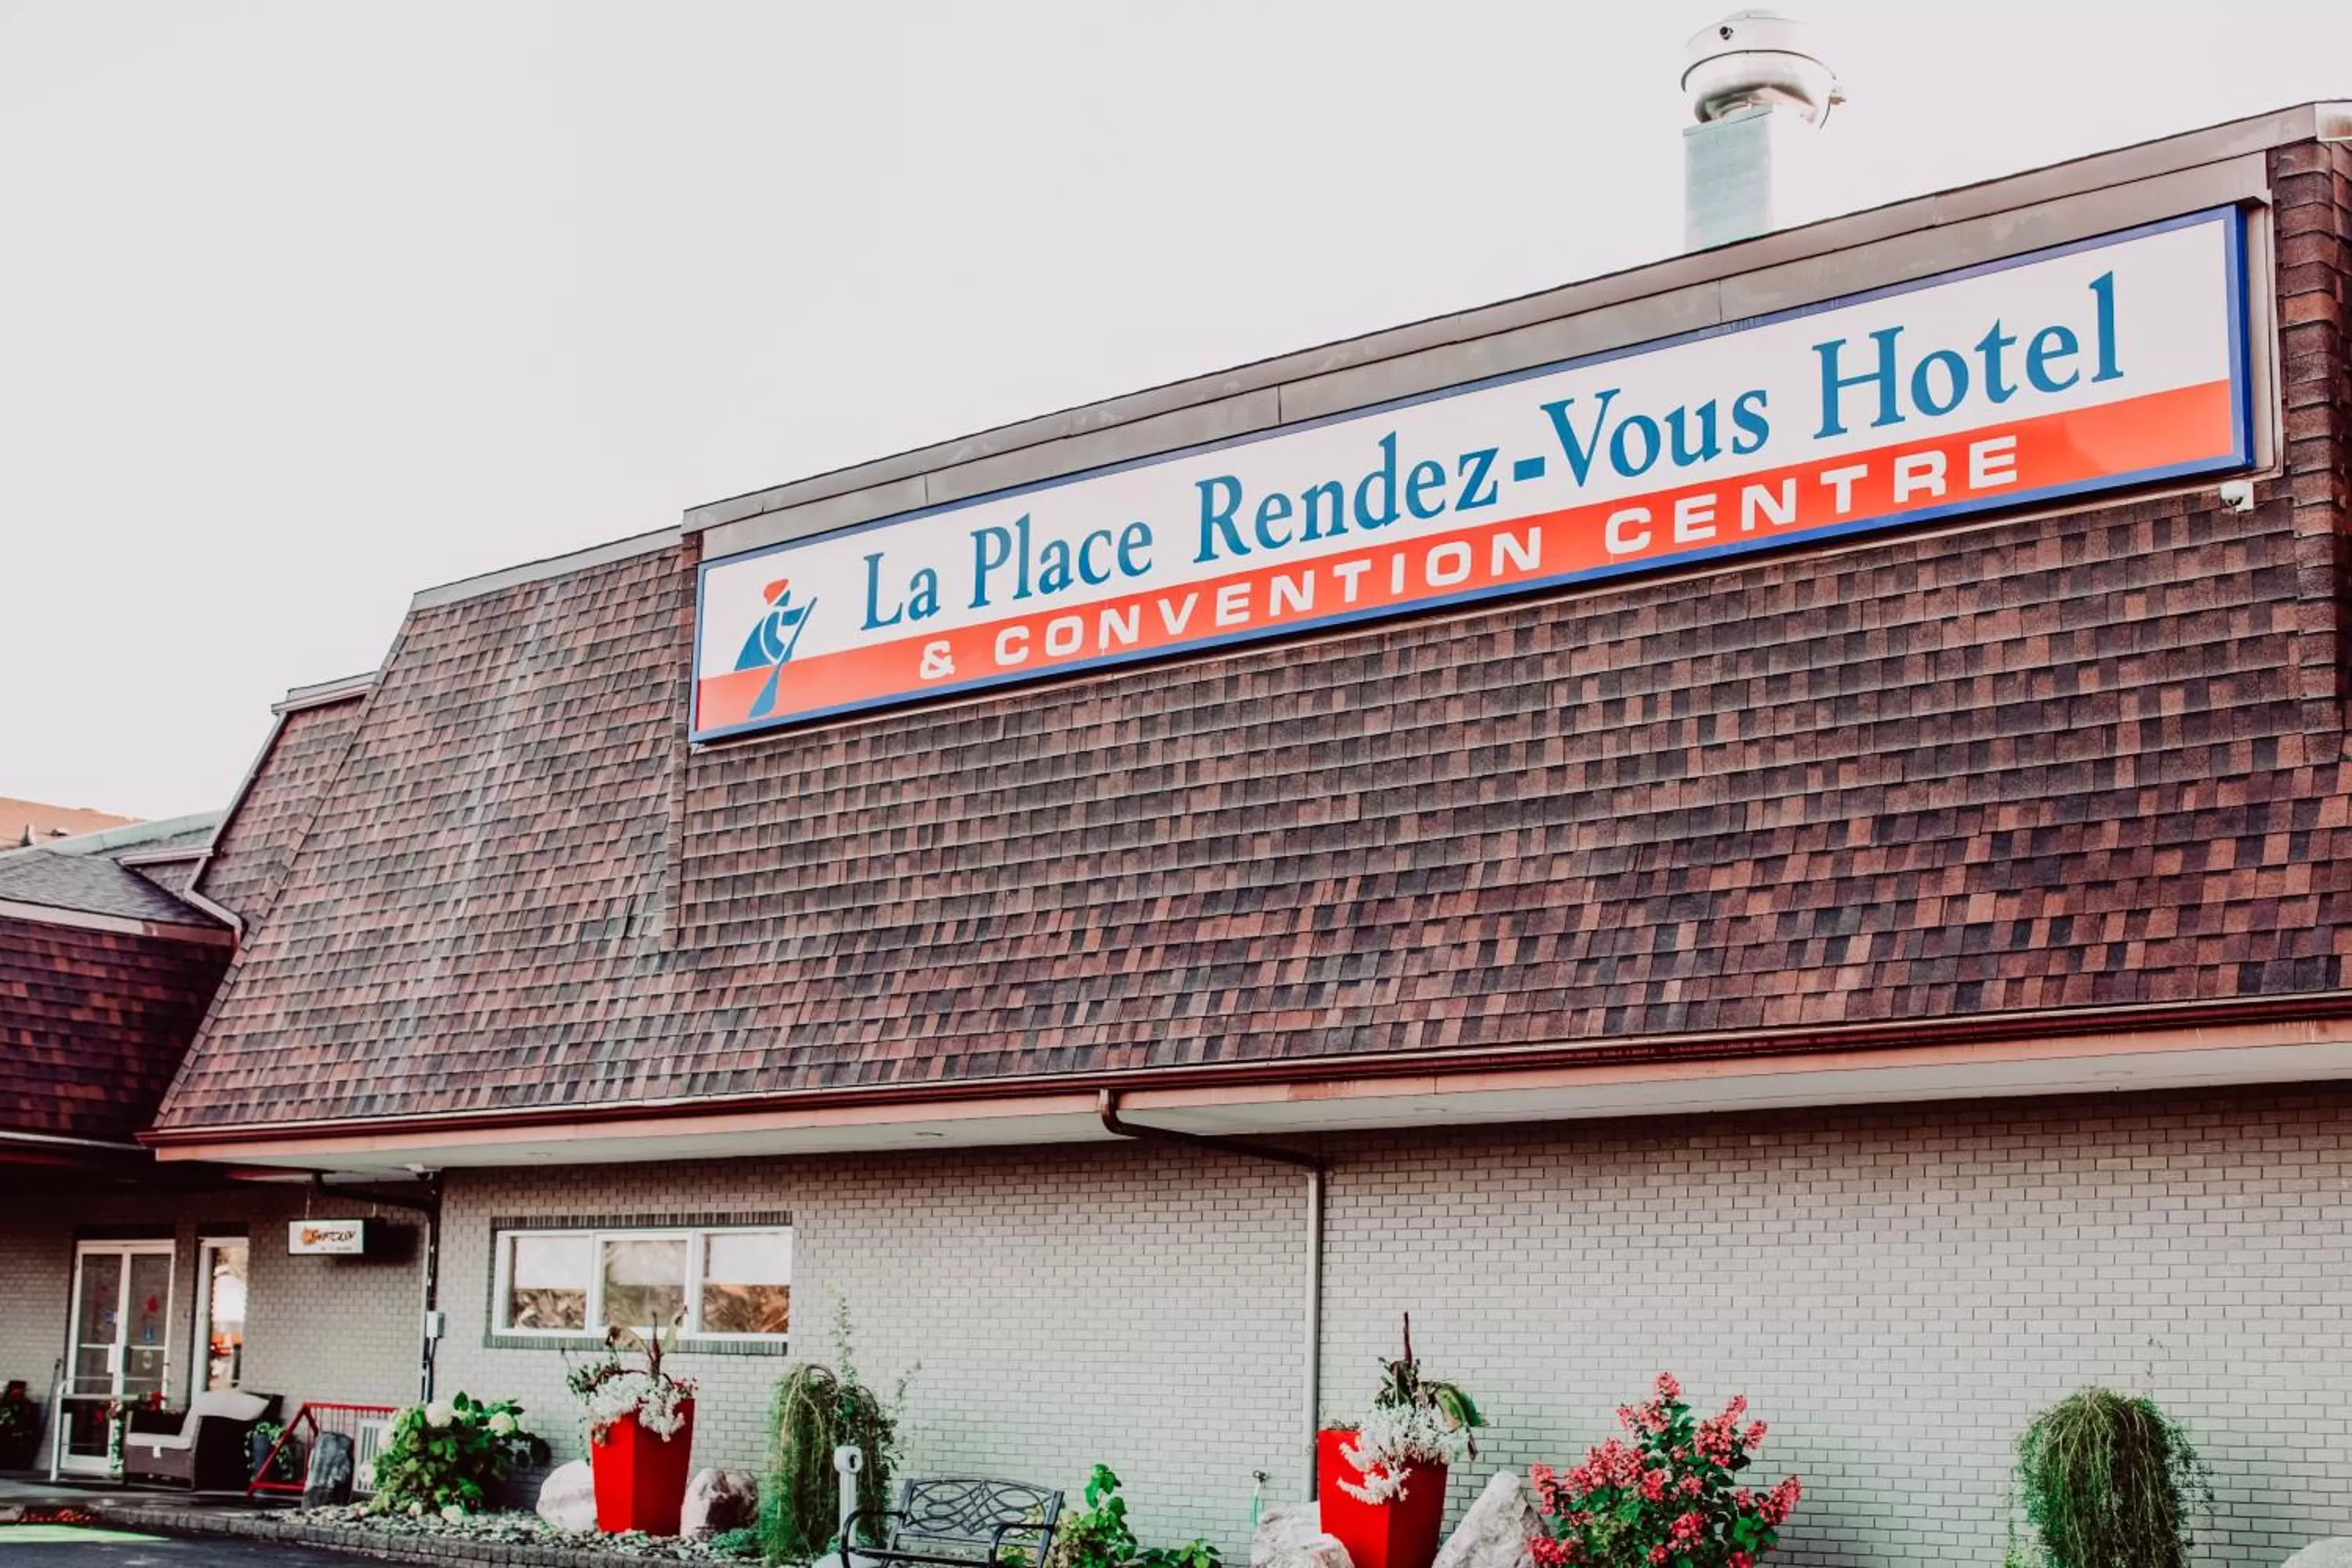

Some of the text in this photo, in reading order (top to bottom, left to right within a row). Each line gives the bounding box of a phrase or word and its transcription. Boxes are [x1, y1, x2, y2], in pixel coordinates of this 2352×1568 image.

[862, 270, 2124, 630] La Place Rendez-Vous Hotel
[920, 435, 2017, 680] & CONVENTION CENTRE
